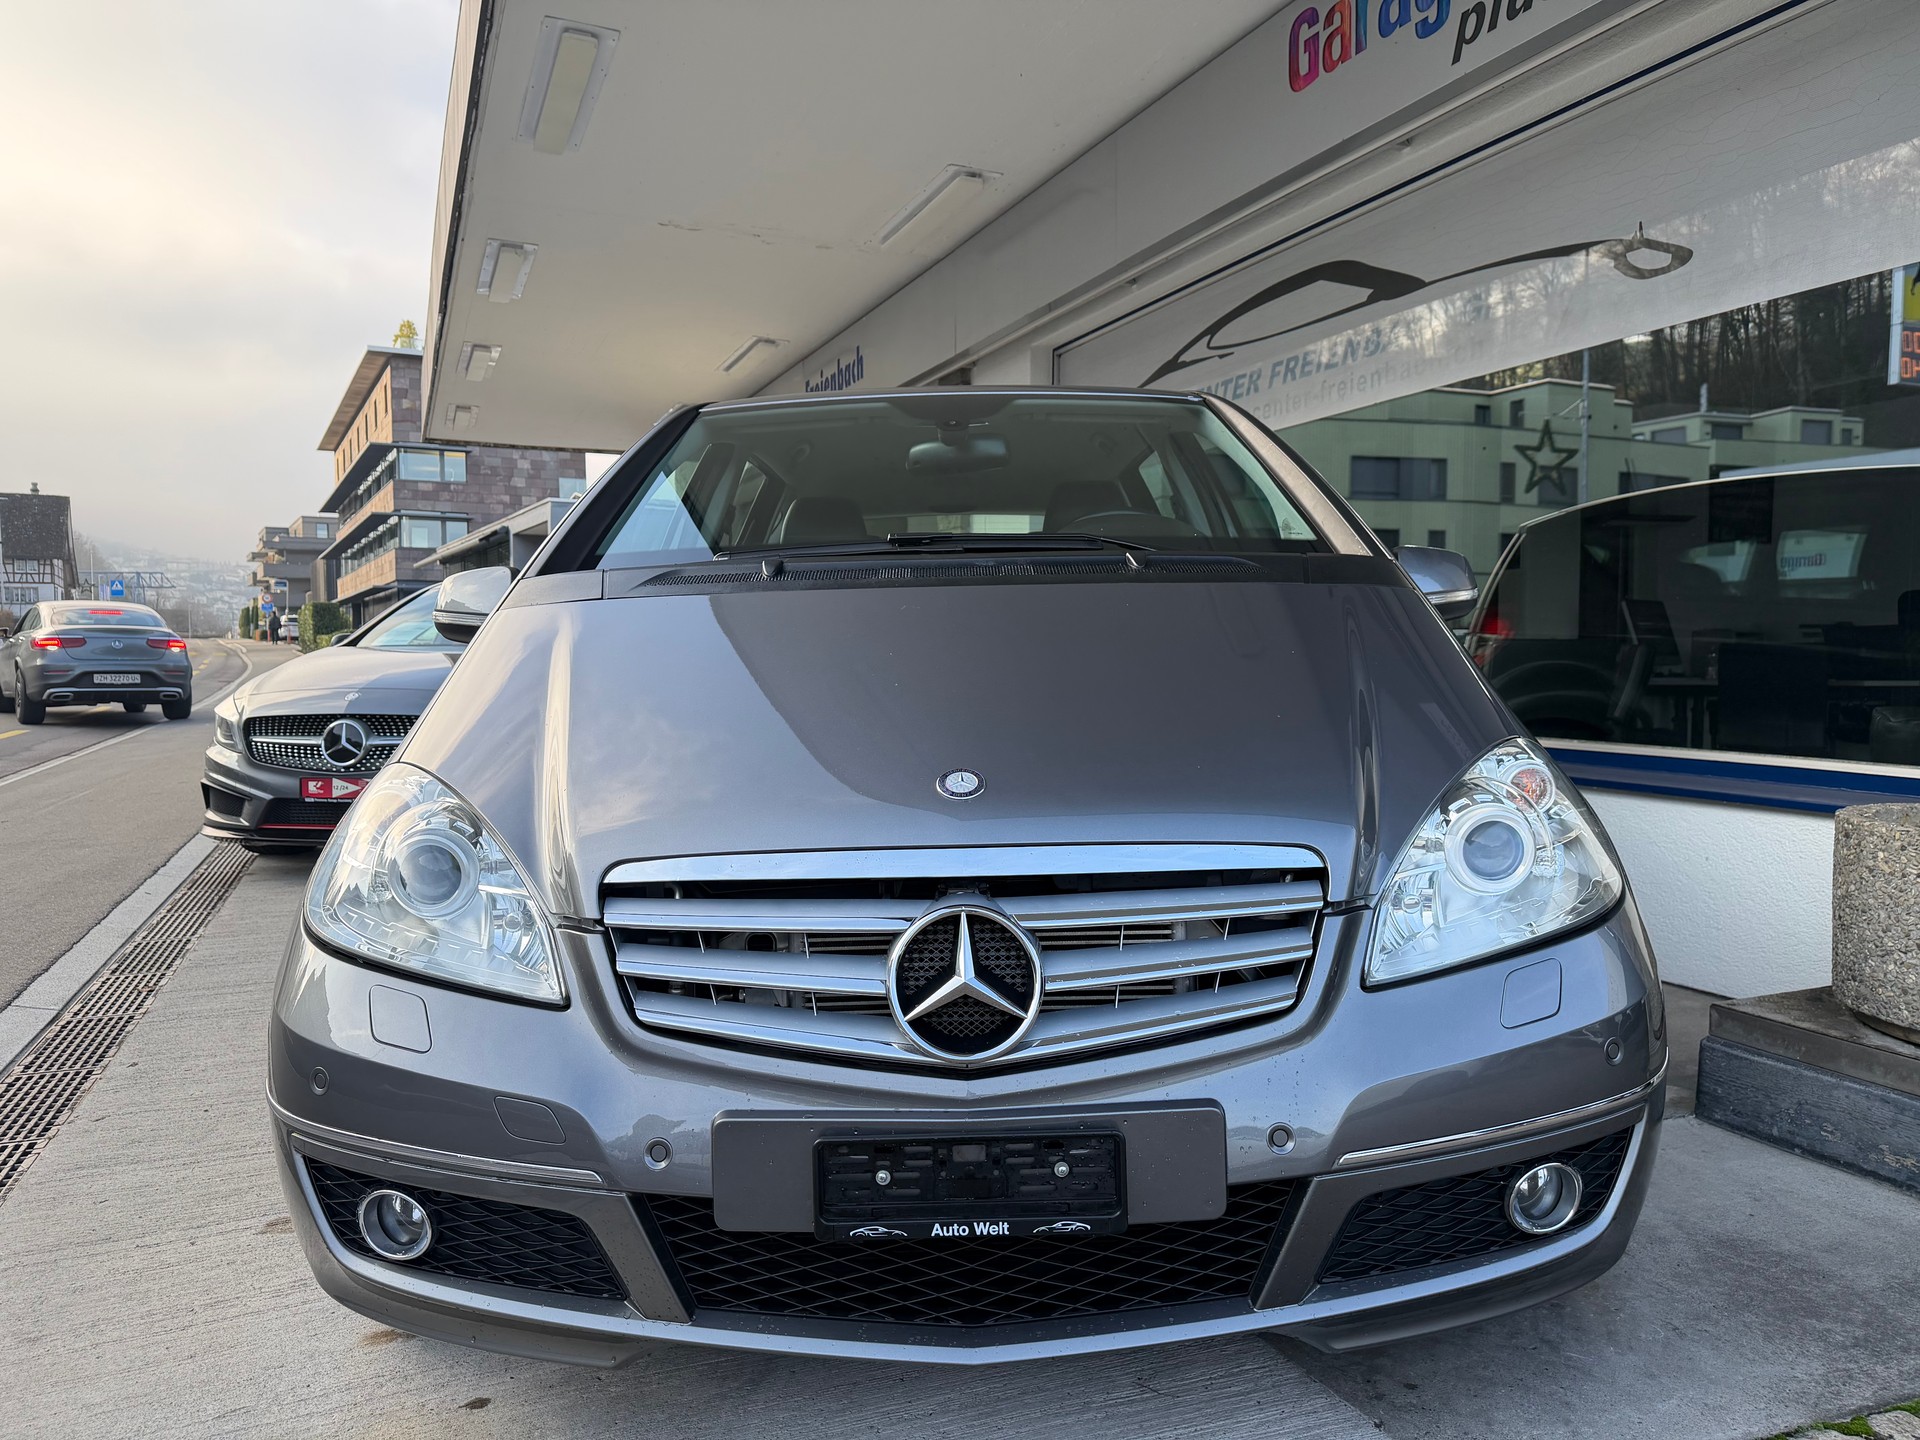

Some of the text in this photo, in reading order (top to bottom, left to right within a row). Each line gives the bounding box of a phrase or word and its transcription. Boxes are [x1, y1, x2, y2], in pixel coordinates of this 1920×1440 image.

[1200, 367, 1262, 401] NTER
[931, 1221, 1010, 1237] Auto Welt
